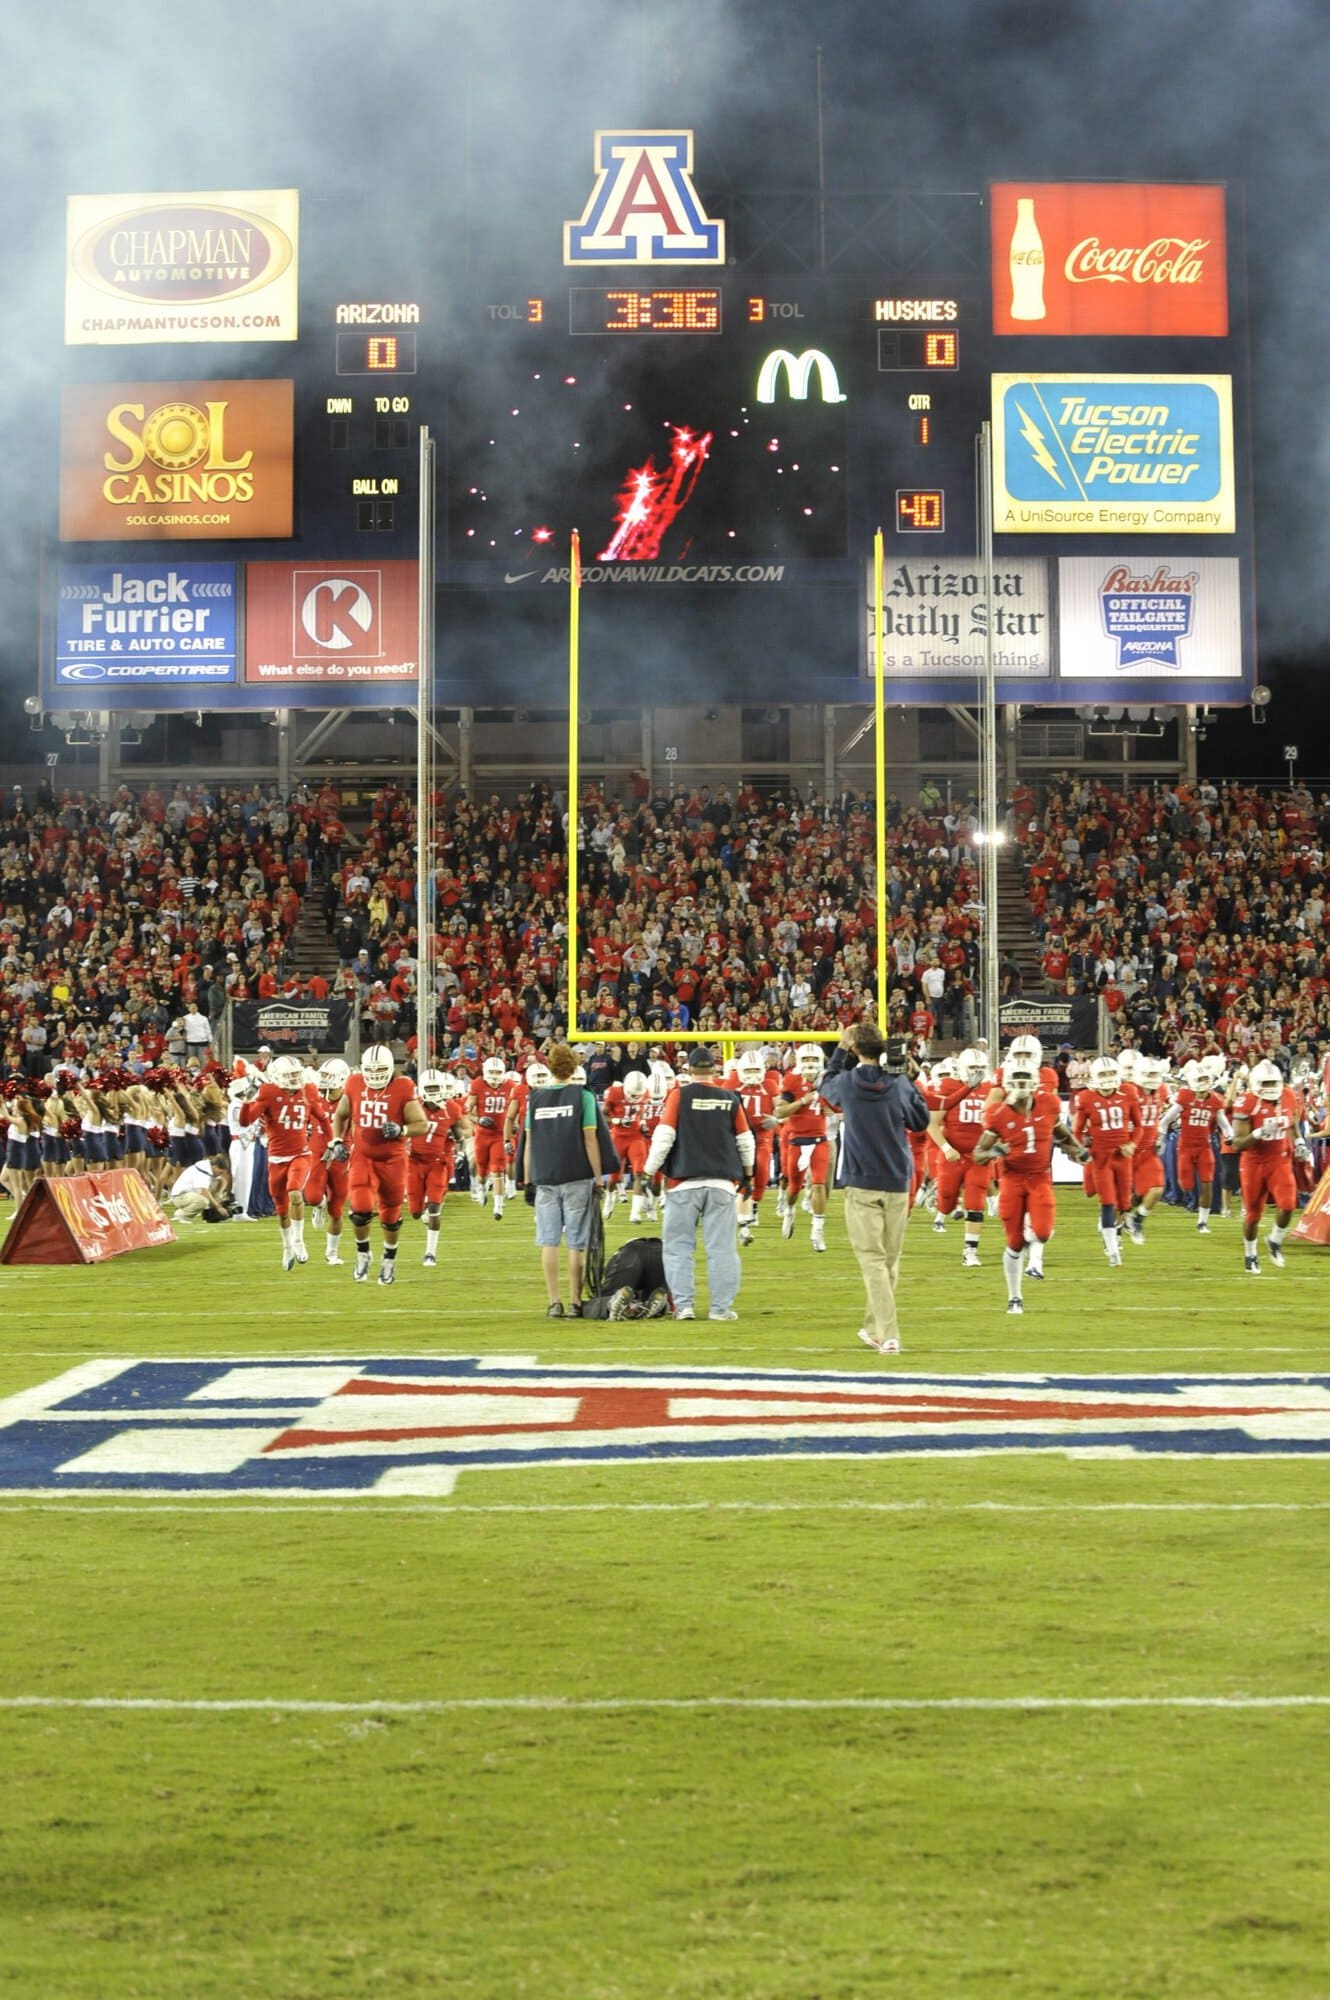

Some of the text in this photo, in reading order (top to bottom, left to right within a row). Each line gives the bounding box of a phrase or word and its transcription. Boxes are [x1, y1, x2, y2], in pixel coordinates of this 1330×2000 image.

[564, 129, 725, 266] A
[110, 228, 254, 267] CHAPMAN
[1064, 236, 1211, 284] Coca-Cola
[113, 266, 250, 282] AUTOMOTIVE
[336, 304, 419, 324] ARIZONA
[488, 304, 522, 320] TOL
[528, 299, 543, 322] 3
[606, 291, 717, 329] 3:36
[749, 298, 764, 321] 3
[769, 303, 804, 319] TOL
[875, 300, 957, 321] HUSKIES
[82, 315, 281, 331] CHAPMANTUCSON.COM
[368, 337, 397, 369] 0
[926, 334, 955, 366] 0
[327, 398, 352, 414] DWN
[375, 398, 409, 413] TO GO
[909, 394, 931, 410] QTR
[1058, 397, 1170, 427] Tucson
[104, 401, 253, 472] SOL
[1070, 426, 1200, 456] Electric
[1084, 456, 1200, 485] Power
[103, 472, 254, 505] CASINOS
[353, 479, 398, 495] BALL ON
[126, 513, 230, 526] SOLCASINOS.COM
[900, 495, 940, 526] 40
[1005, 509, 1222, 526] A UniSource Energy Company
[541, 565, 785, 584] ARZONAWILDCATS.COM
[103, 572, 190, 604] Jack
[1109, 599, 1186, 610] OFFICIAL
[82, 603, 210, 634] Furrier
[306, 579, 372, 650] K
[866, 603, 1046, 645] Daily Star
[1109, 611, 1186, 623] TAILGATE
[1109, 624, 1186, 632] HEADQUARTERS
[67, 638, 225, 652] TIRE & AUTO CARE
[1123, 641, 1174, 651] ARIZONA
[869, 651, 1040, 669] I's a Tucson thing
[258, 663, 416, 677] What else do you need?
[47, 752, 58, 766] 27
[665, 746, 678, 760] 28
[1284, 745, 1298, 760] 29
[1001, 1008, 1041, 1016] AMERICAN
[360, 1100, 388, 1128] 55
[484, 1096, 506, 1113] 90
[534, 1105, 573, 1120] ESPN
[691, 1098, 733, 1112] ESPN
[959, 1099, 986, 1123] 62
[277, 1105, 306, 1130] 43
[1021, 1126, 1037, 1153] 1
